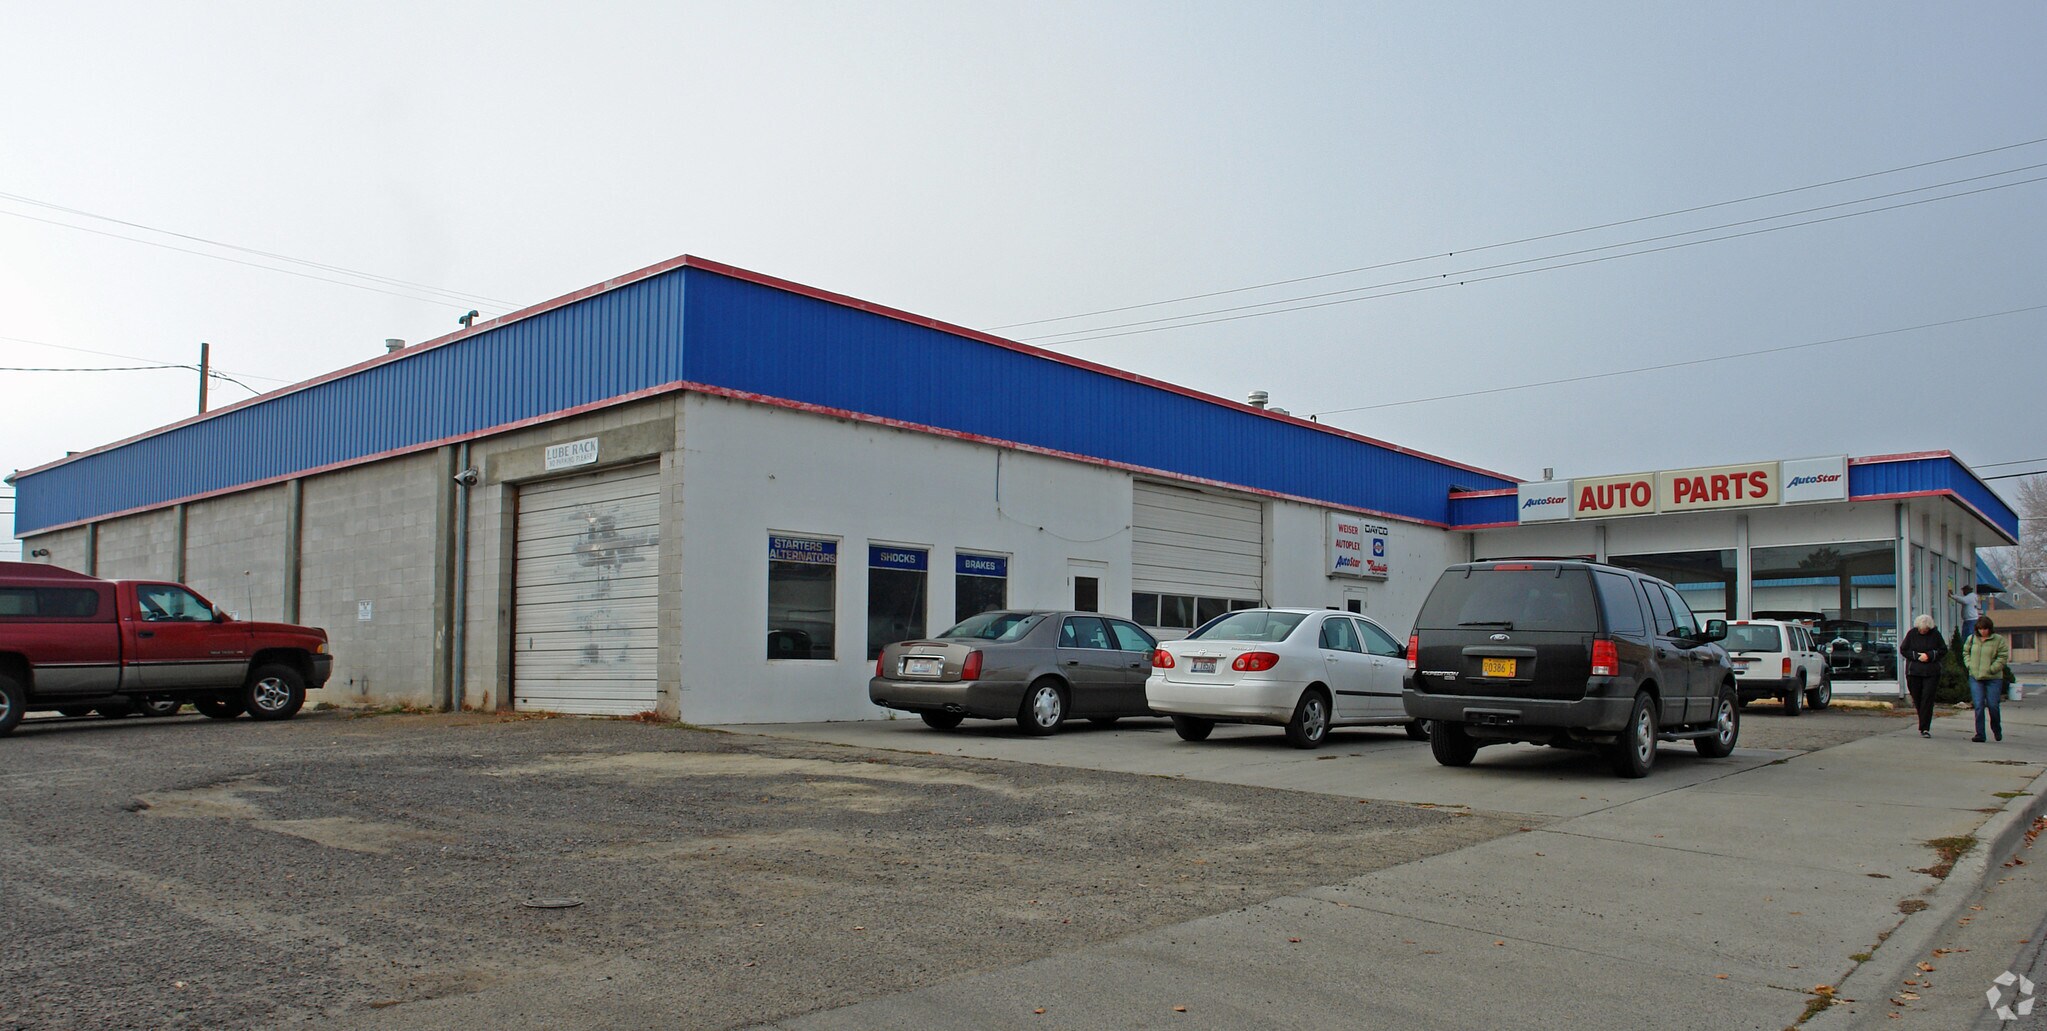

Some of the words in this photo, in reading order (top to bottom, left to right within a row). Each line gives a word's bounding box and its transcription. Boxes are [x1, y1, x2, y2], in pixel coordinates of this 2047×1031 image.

[547, 446, 569, 460] LUBE
[572, 440, 596, 455] RACK
[1784, 474, 1842, 489] AutoStar
[1578, 481, 1652, 512] AUTO
[1673, 471, 1769, 504] PARTS
[1522, 496, 1567, 509] AutoStar
[1338, 524, 1358, 535] WEISER
[1365, 524, 1388, 535] DAYCO
[774, 538, 822, 551] STARTERS
[1336, 539, 1360, 551] AUTOPLEX
[769, 549, 836, 563] ALTERNATORS
[880, 552, 916, 564] SHOCKS
[1335, 555, 1360, 569] AutoStar
[965, 559, 996, 571] BRAKES
